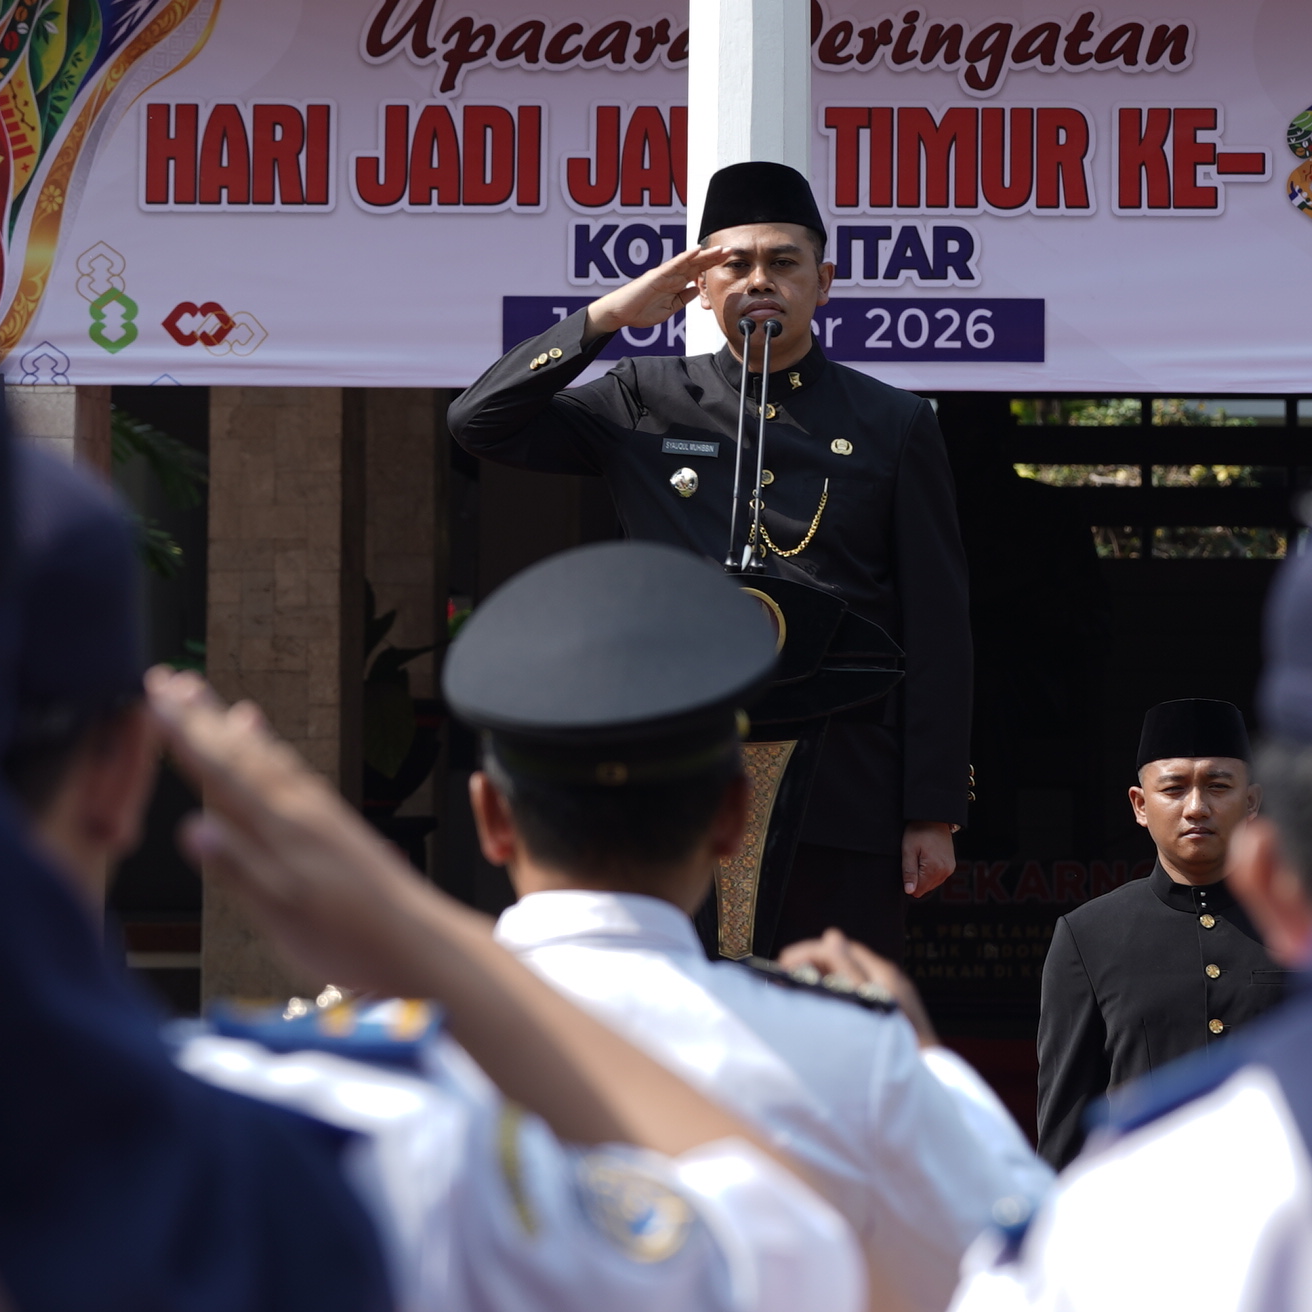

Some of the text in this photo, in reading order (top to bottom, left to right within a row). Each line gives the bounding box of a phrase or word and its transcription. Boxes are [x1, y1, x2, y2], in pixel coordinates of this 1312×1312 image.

[144, 103, 331, 206] HARI
[355, 104, 539, 207] JADI
[823, 106, 1089, 209] TIMUR
[1117, 107, 1266, 209] KE-
[865, 307, 995, 349] 2026
